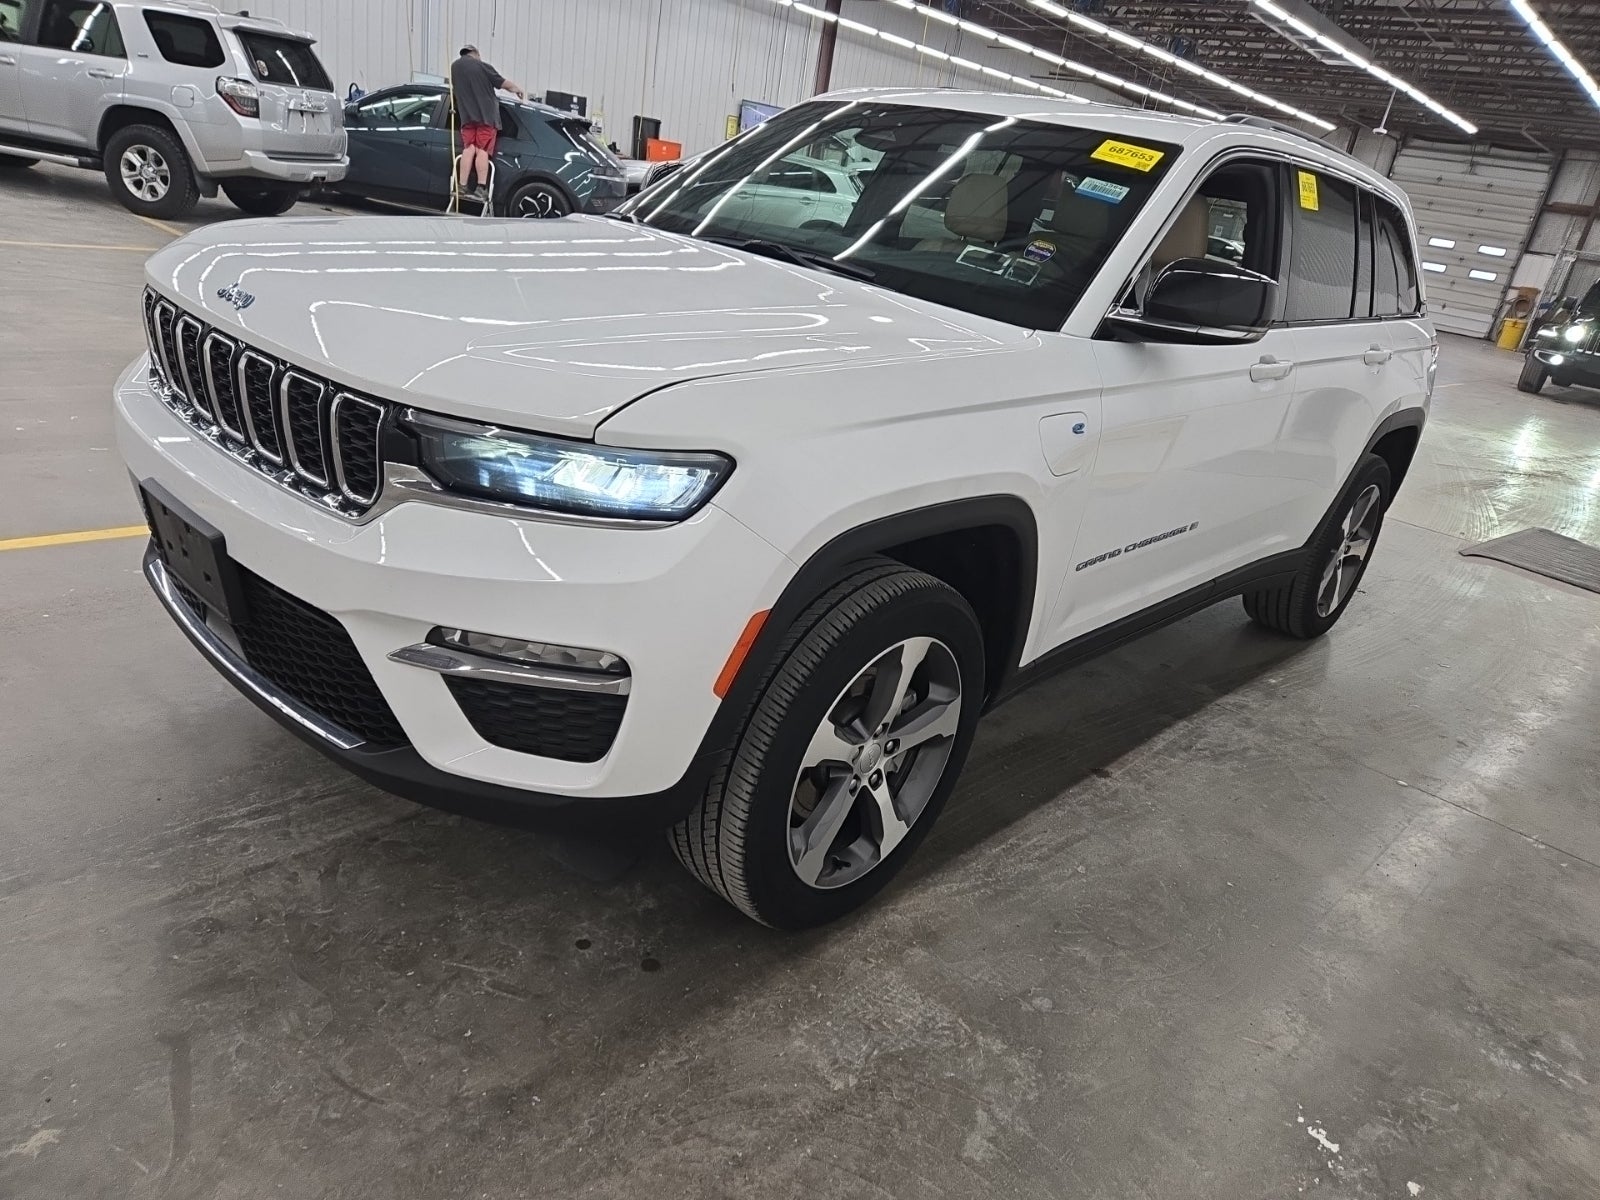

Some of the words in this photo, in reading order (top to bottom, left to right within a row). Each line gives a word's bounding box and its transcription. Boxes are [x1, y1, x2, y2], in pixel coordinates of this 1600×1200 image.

[1108, 145, 1154, 162] 687653
[217, 282, 256, 311] Jeep
[1075, 548, 1122, 572] GRAND
[1123, 525, 1189, 553] CHEROKEE
